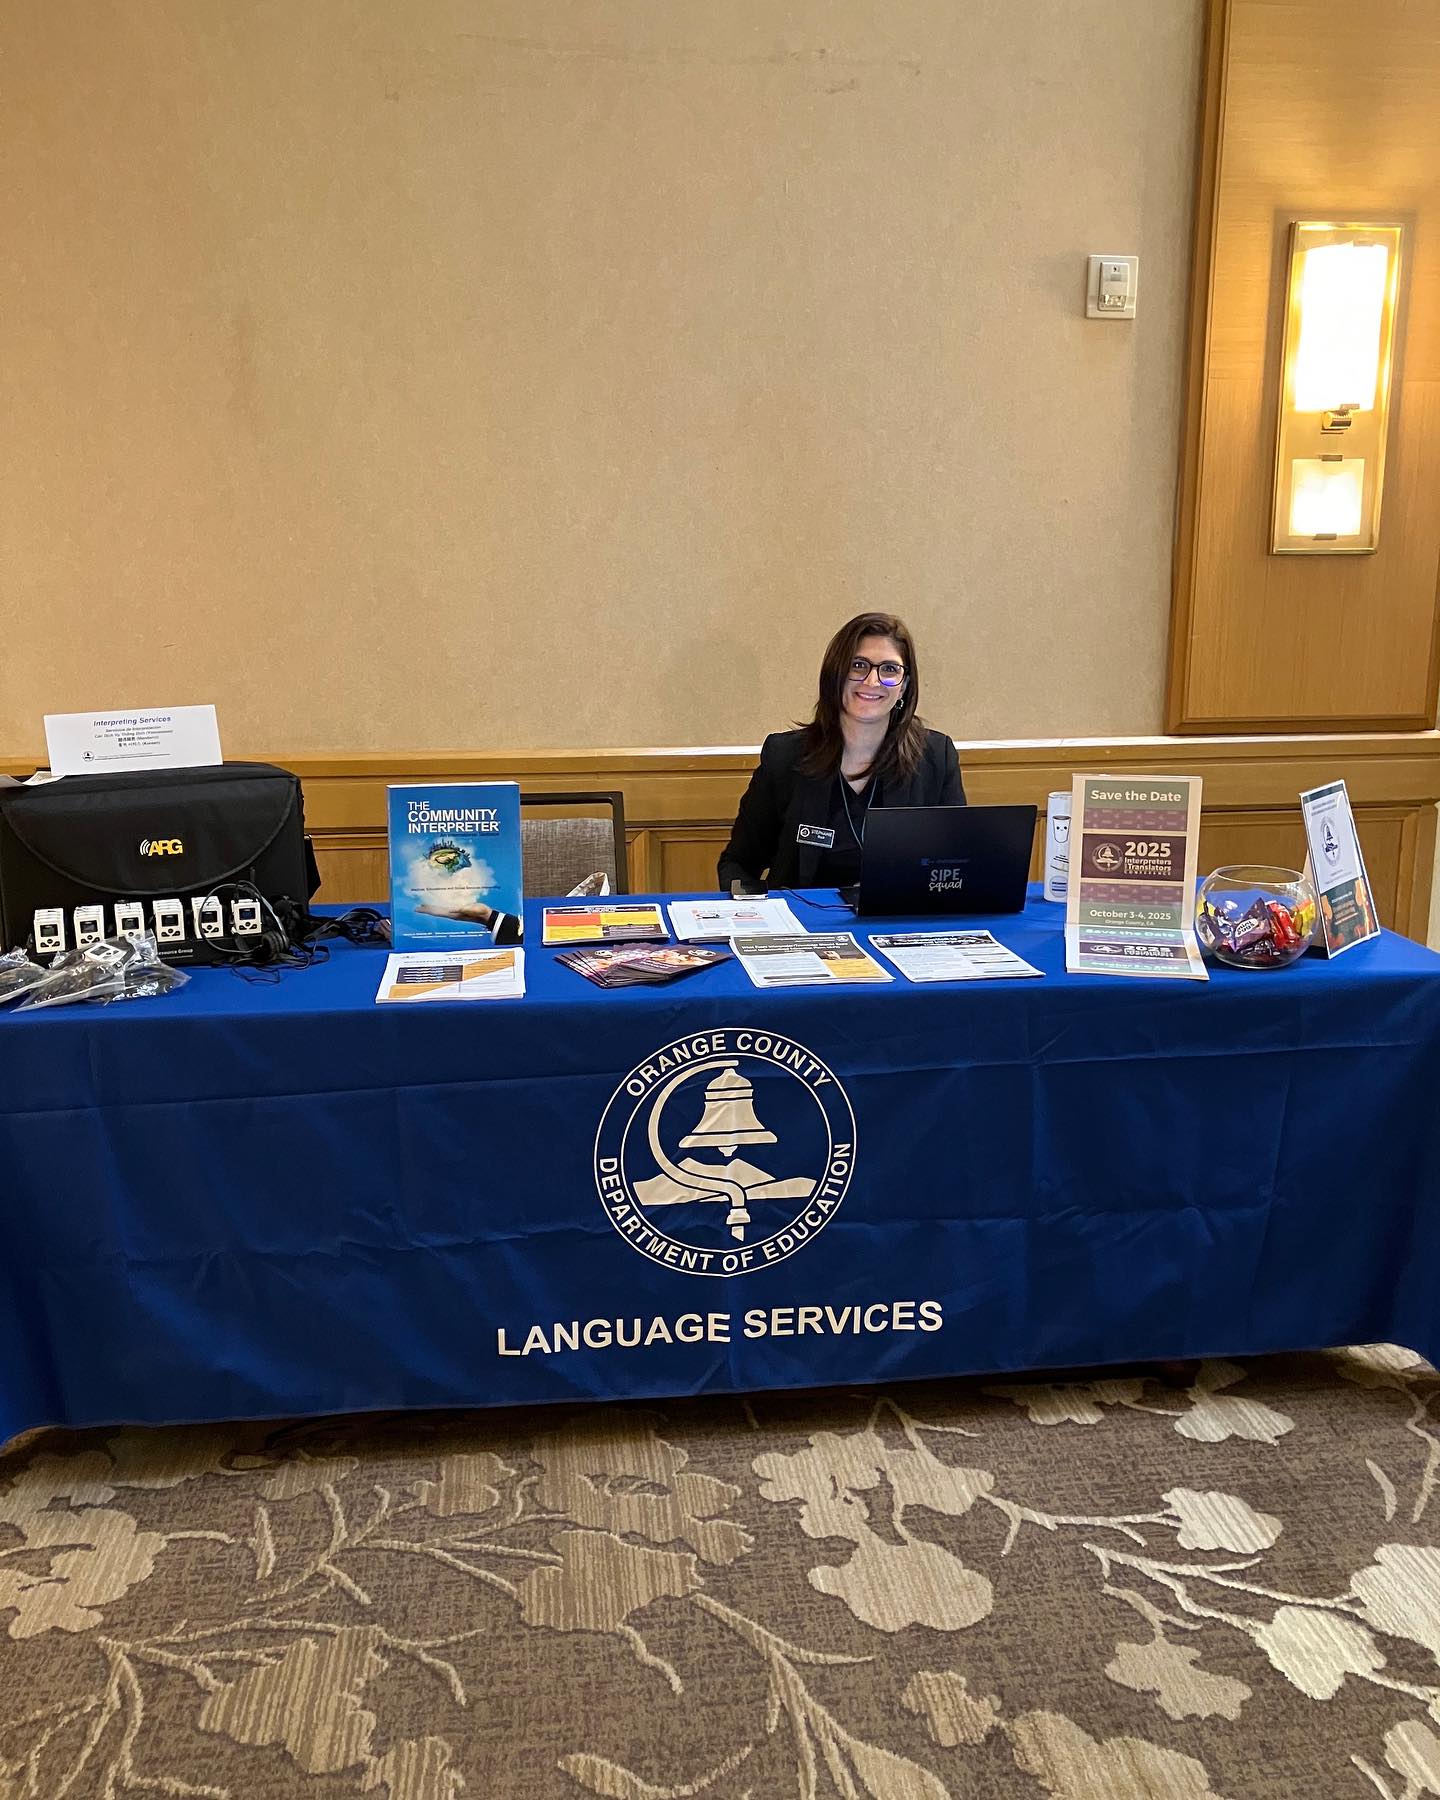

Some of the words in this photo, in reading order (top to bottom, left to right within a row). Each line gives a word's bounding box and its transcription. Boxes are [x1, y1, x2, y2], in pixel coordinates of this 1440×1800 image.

[93, 718, 137, 727] Interpreting
[139, 716, 171, 724] Services
[1091, 789, 1122, 801] Save
[1125, 790, 1147, 801] the
[1150, 791, 1182, 802] Date
[407, 801, 430, 811] THE
[408, 808, 498, 823] COMMUNITY
[408, 821, 499, 834] INTERPRETER
[147, 838, 183, 857] ARG
[1124, 841, 1171, 858] 2025
[1124, 857, 1172, 866] Interpreters
[1128, 863, 1172, 872] Translators
[930, 868, 961, 881] SIPE
[928, 878, 963, 892] squad
[1090, 909, 1128, 918] October
[1147, 912, 1171, 920] 2025
[626, 1033, 726, 1098] ORANGE
[736, 1033, 832, 1088] COUNTY
[599, 1157, 714, 1271] DEPARTMENT
[722, 1252, 754, 1272] OF
[762, 1143, 851, 1260] EDUCATION
[497, 1313, 731, 1356] LANGUAGE
[743, 1300, 943, 1338] SERVICES
